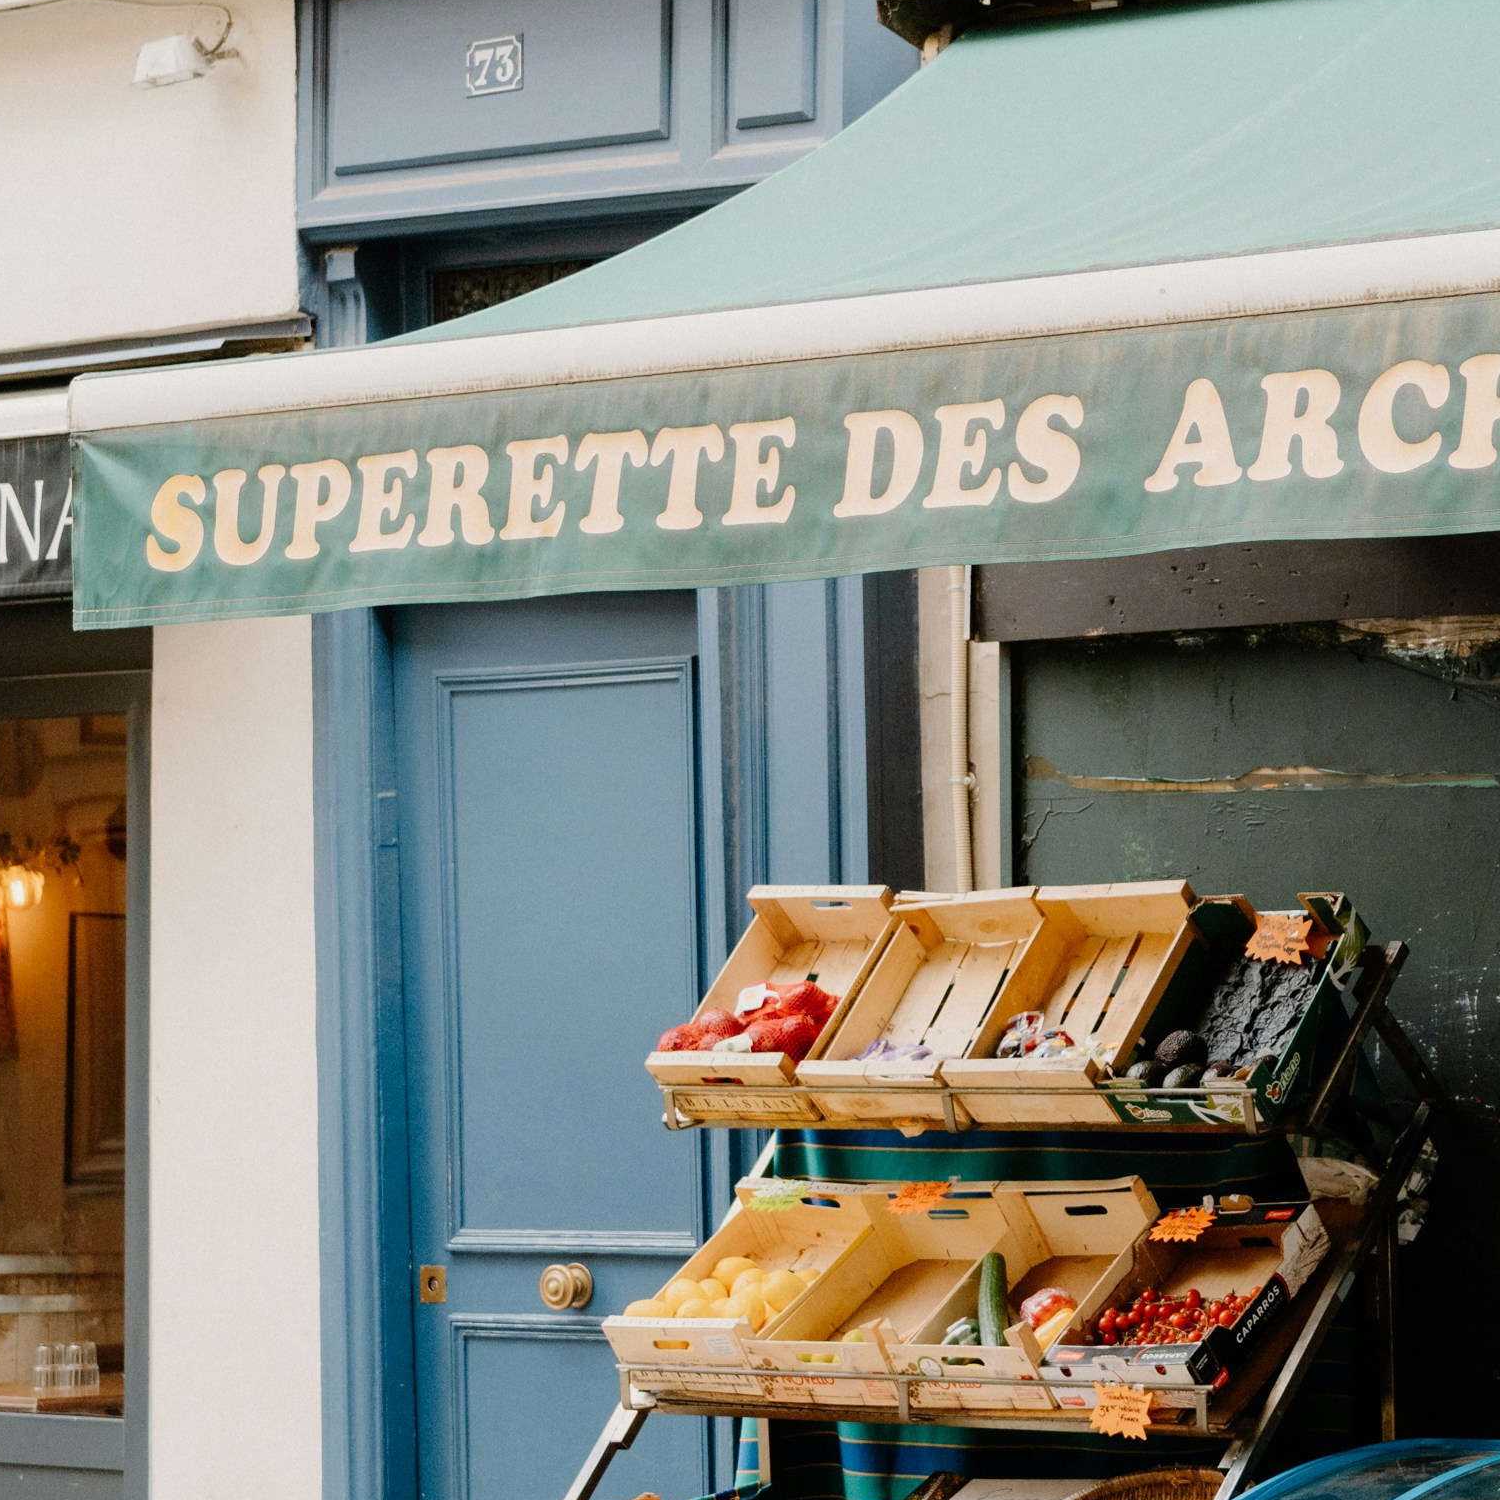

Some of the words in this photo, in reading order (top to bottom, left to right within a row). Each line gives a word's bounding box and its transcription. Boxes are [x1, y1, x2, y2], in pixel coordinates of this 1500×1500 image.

[473, 43, 513, 87] 73
[146, 415, 796, 573] SUPERETTE
[833, 393, 1083, 520] DES
